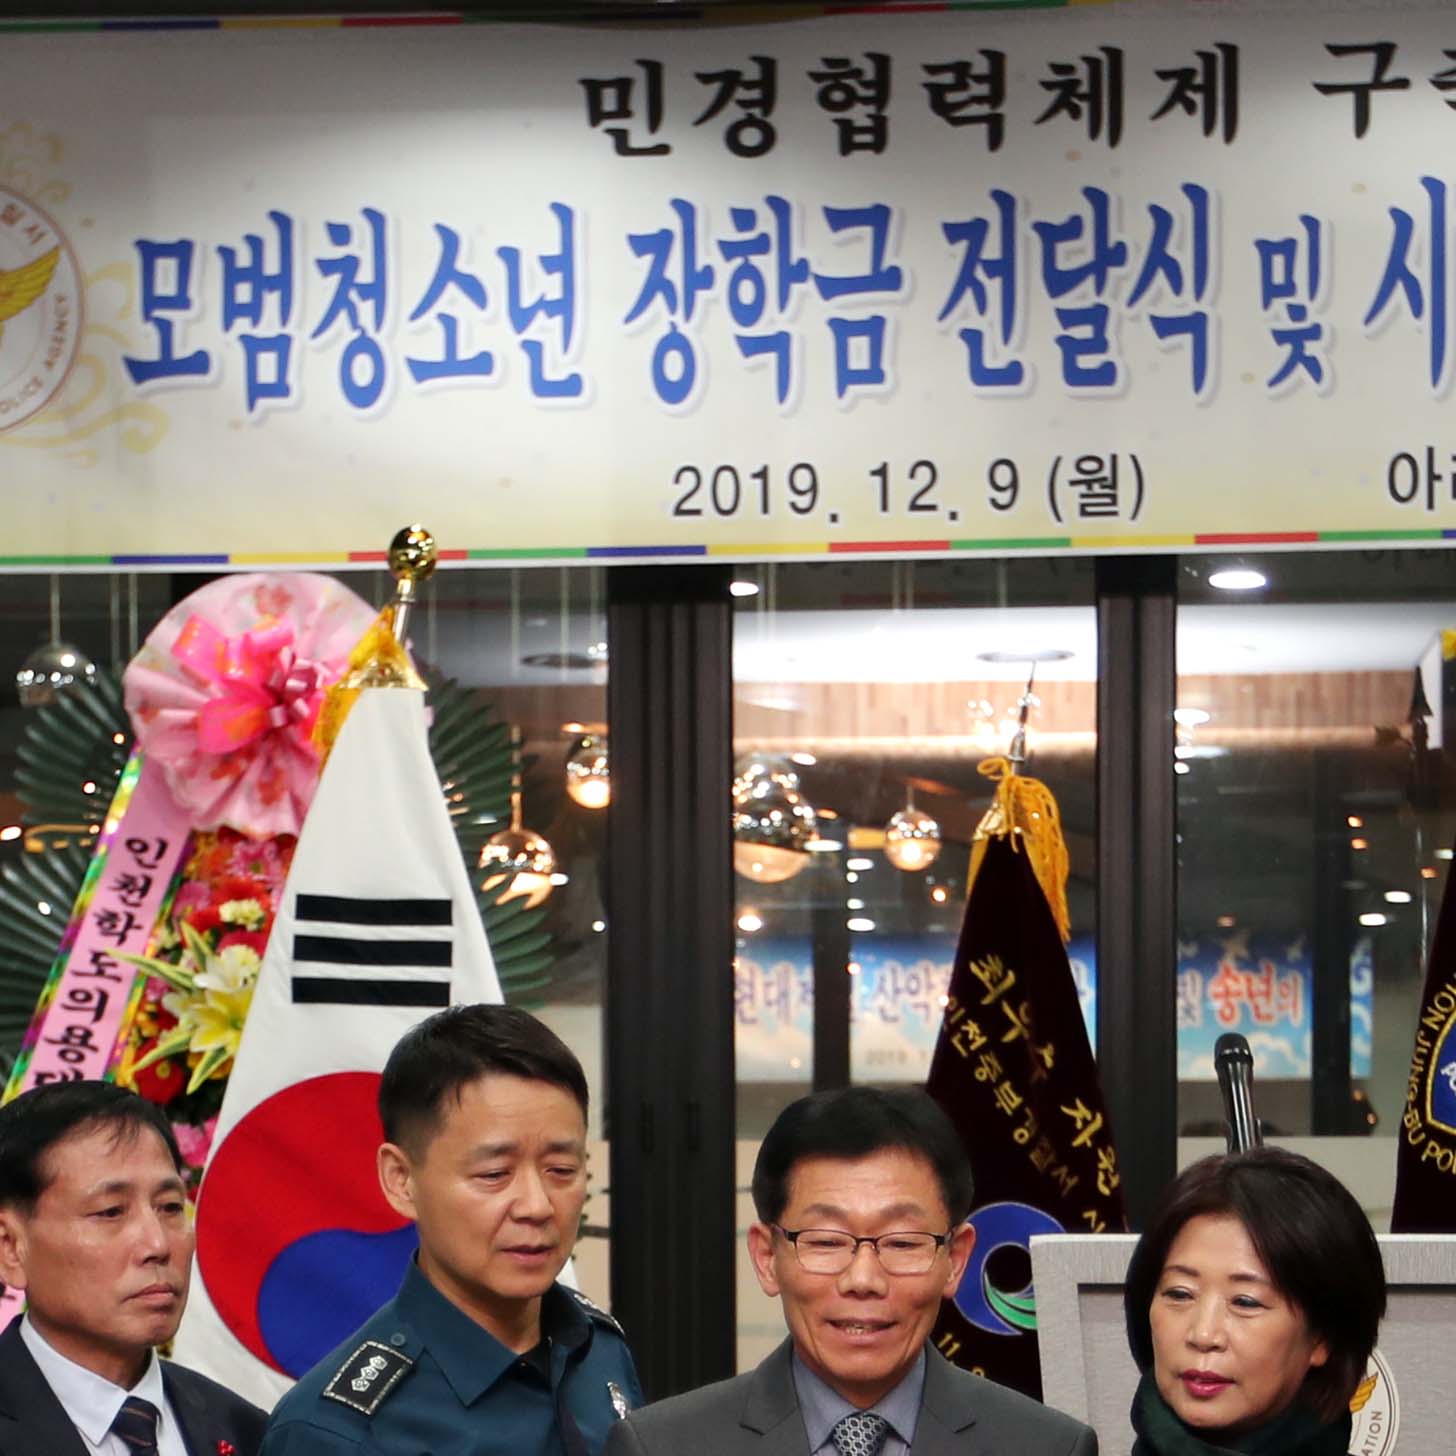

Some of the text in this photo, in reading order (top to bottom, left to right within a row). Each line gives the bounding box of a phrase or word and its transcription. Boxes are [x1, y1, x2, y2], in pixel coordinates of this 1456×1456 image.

[578, 42, 1240, 157] 민경협력체제
[126, 203, 586, 411] 모범청소년
[626, 195, 905, 404] 장학금
[940, 183, 1211, 392] 전달식
[1255, 214, 1325, 387] 및
[674, 462, 838, 524] 2019.
[871, 459, 958, 522] 12.
[1211, 960, 1302, 1024] 송년의
